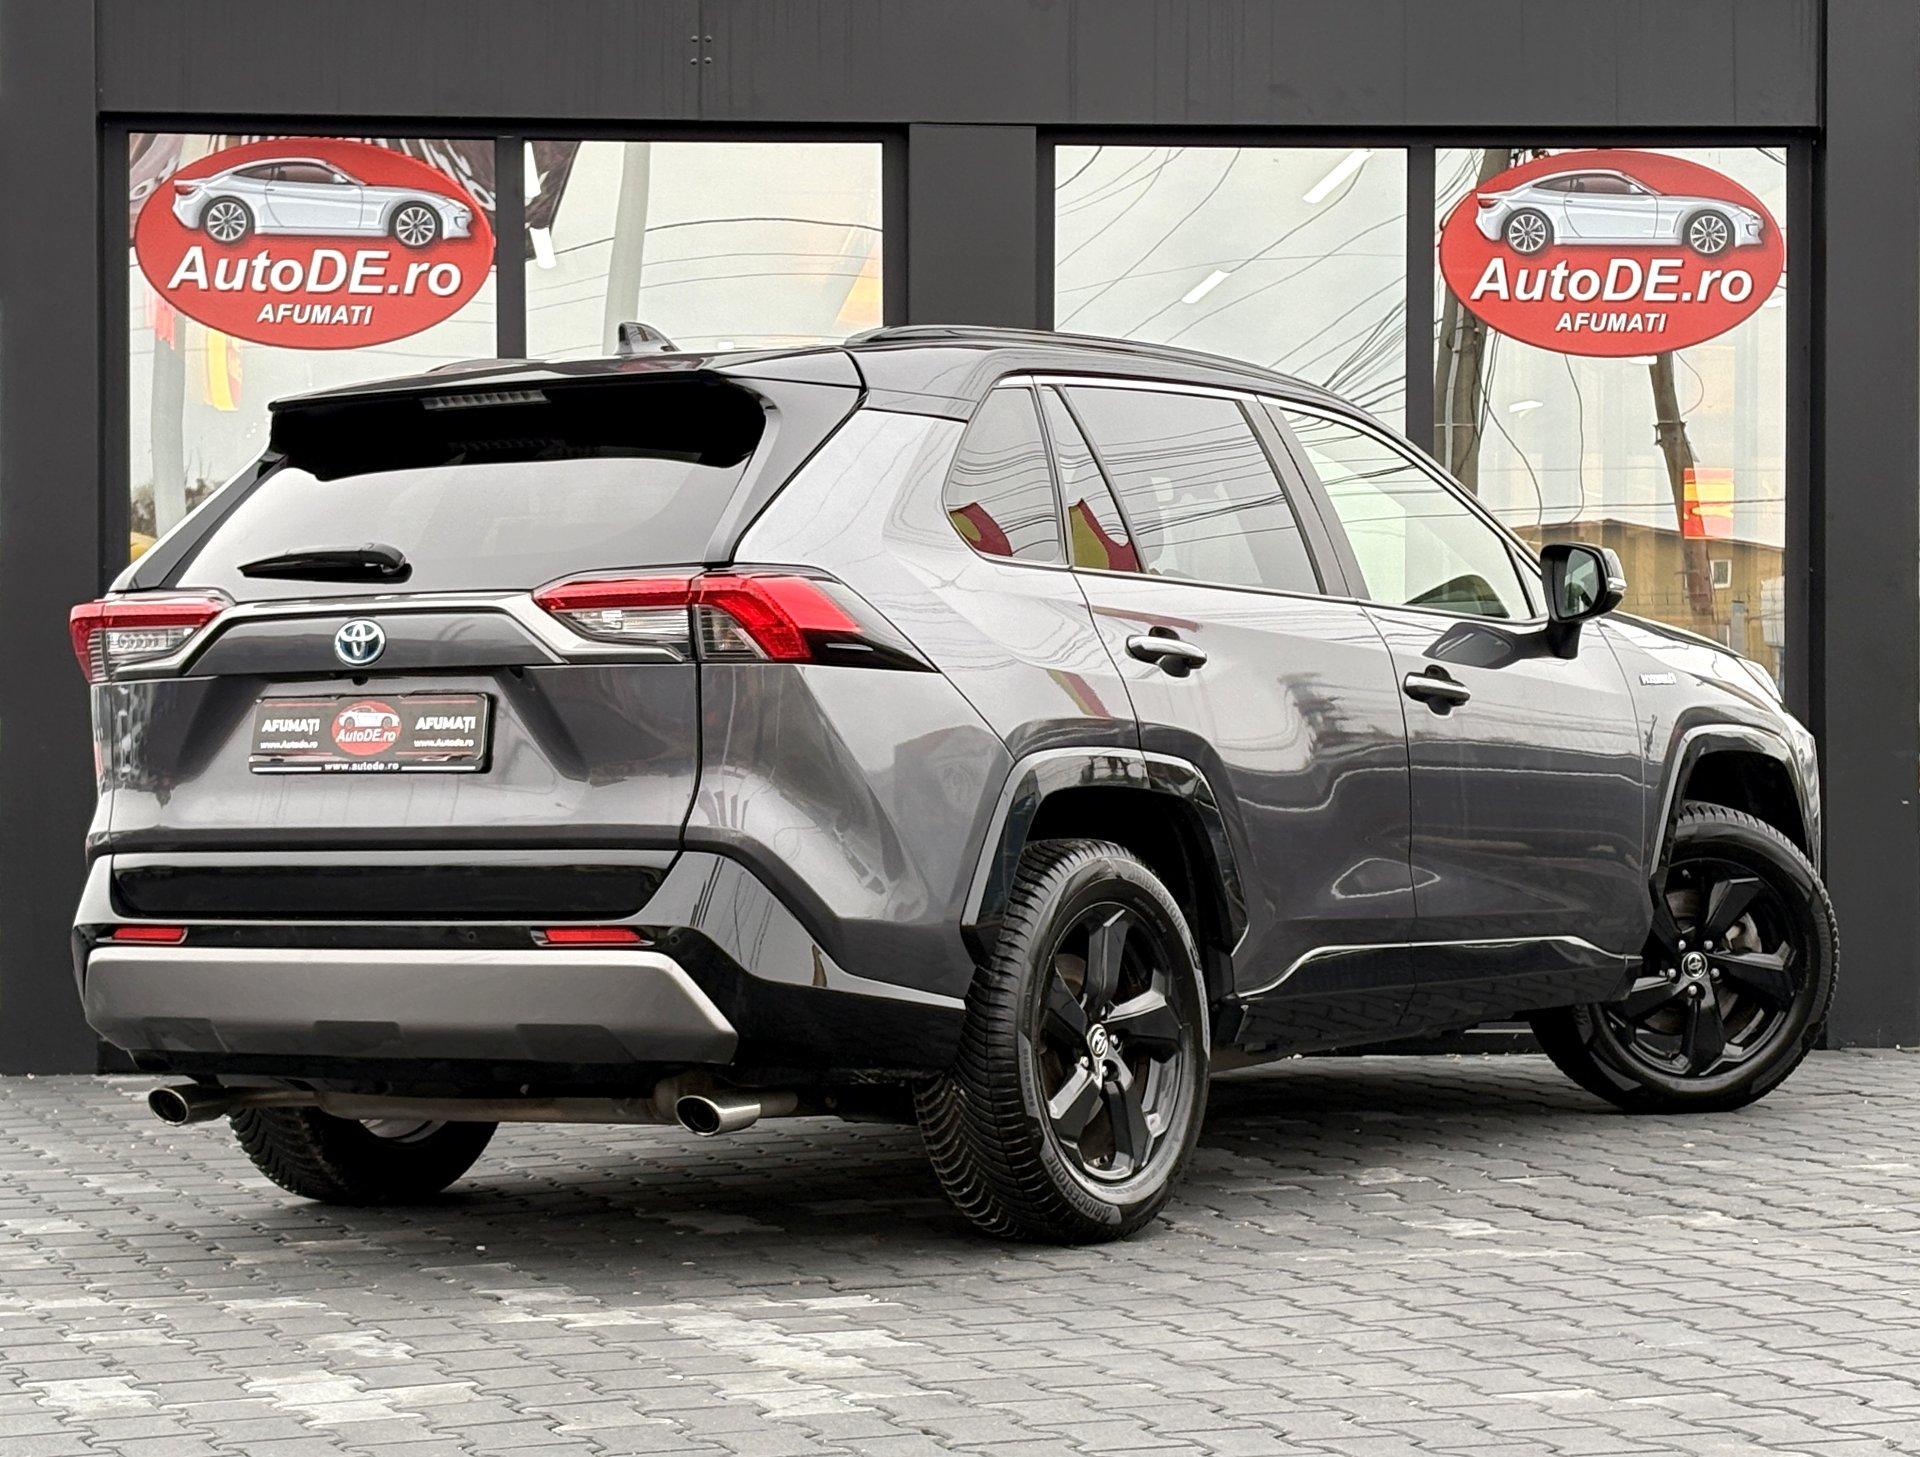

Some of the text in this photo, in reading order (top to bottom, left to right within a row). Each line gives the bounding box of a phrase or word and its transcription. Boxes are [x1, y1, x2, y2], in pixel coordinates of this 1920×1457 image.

[167, 246, 462, 296] AutoDE.ro
[1470, 258, 1753, 303] AutoDE.ro
[257, 304, 373, 325] AFUMATI
[1555, 313, 1667, 333] AFUMATI
[335, 728, 396, 743] AutoDE.ro
